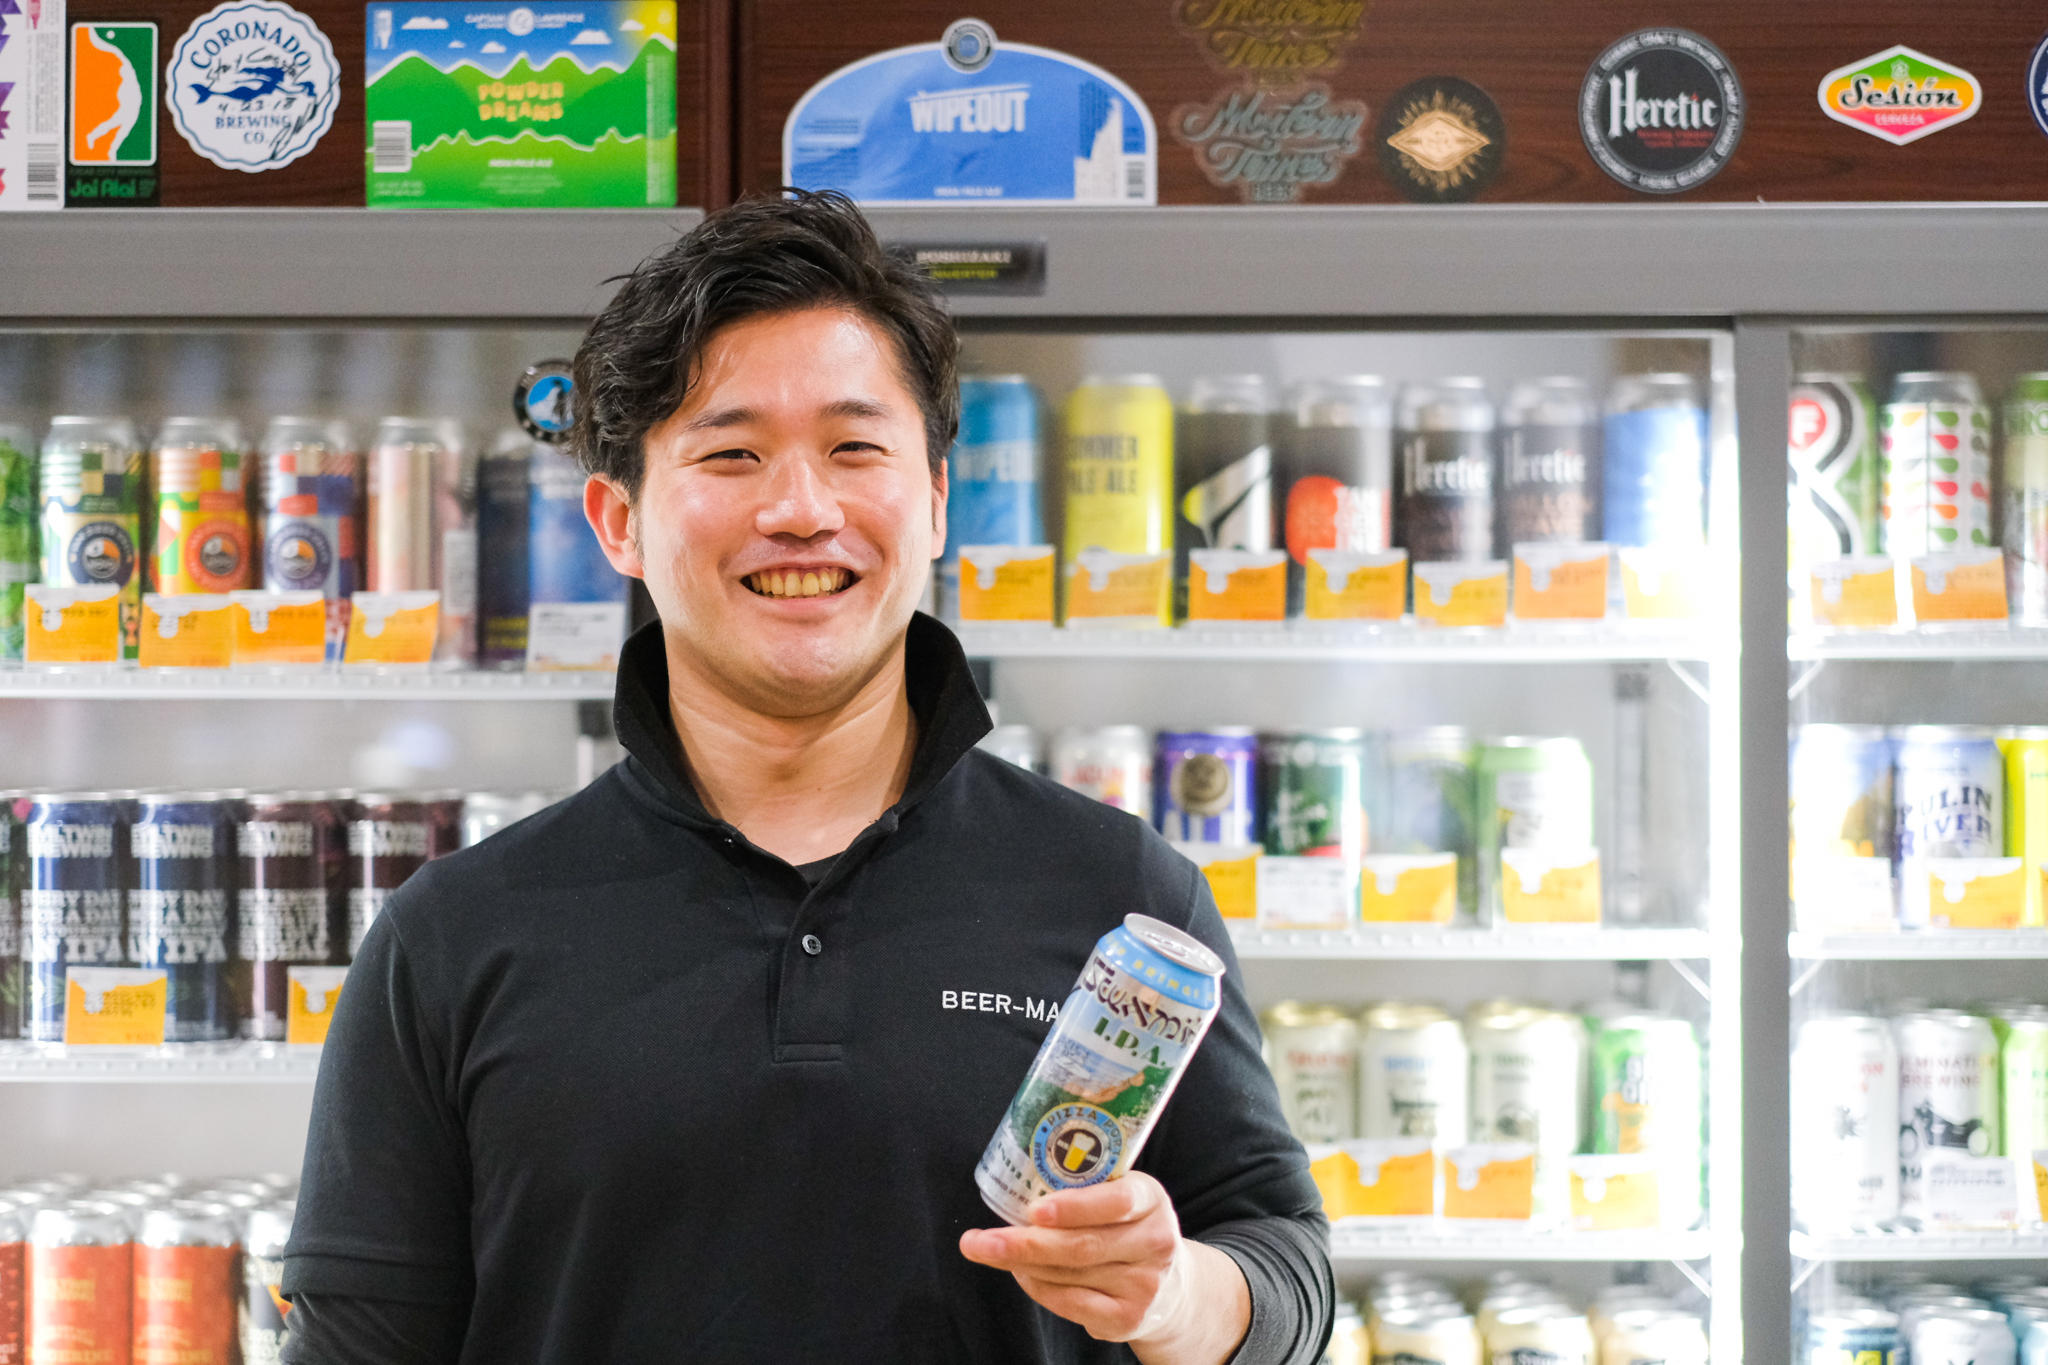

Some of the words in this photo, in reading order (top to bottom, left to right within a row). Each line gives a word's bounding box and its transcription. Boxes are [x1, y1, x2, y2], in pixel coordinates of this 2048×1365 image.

[191, 21, 310, 69] CORONADO
[909, 86, 1029, 132] WIPEOUT
[1607, 65, 1717, 138] Heretic
[1841, 77, 1962, 107] Sesión
[215, 115, 292, 130] BREWING
[69, 178, 98, 198] Jai
[1093, 1016, 1167, 1066] I.P.A.
[1046, 1106, 1097, 1126] PIZZA
[1103, 1118, 1122, 1156] PORT
[1034, 1142, 1059, 1188] BREWING
